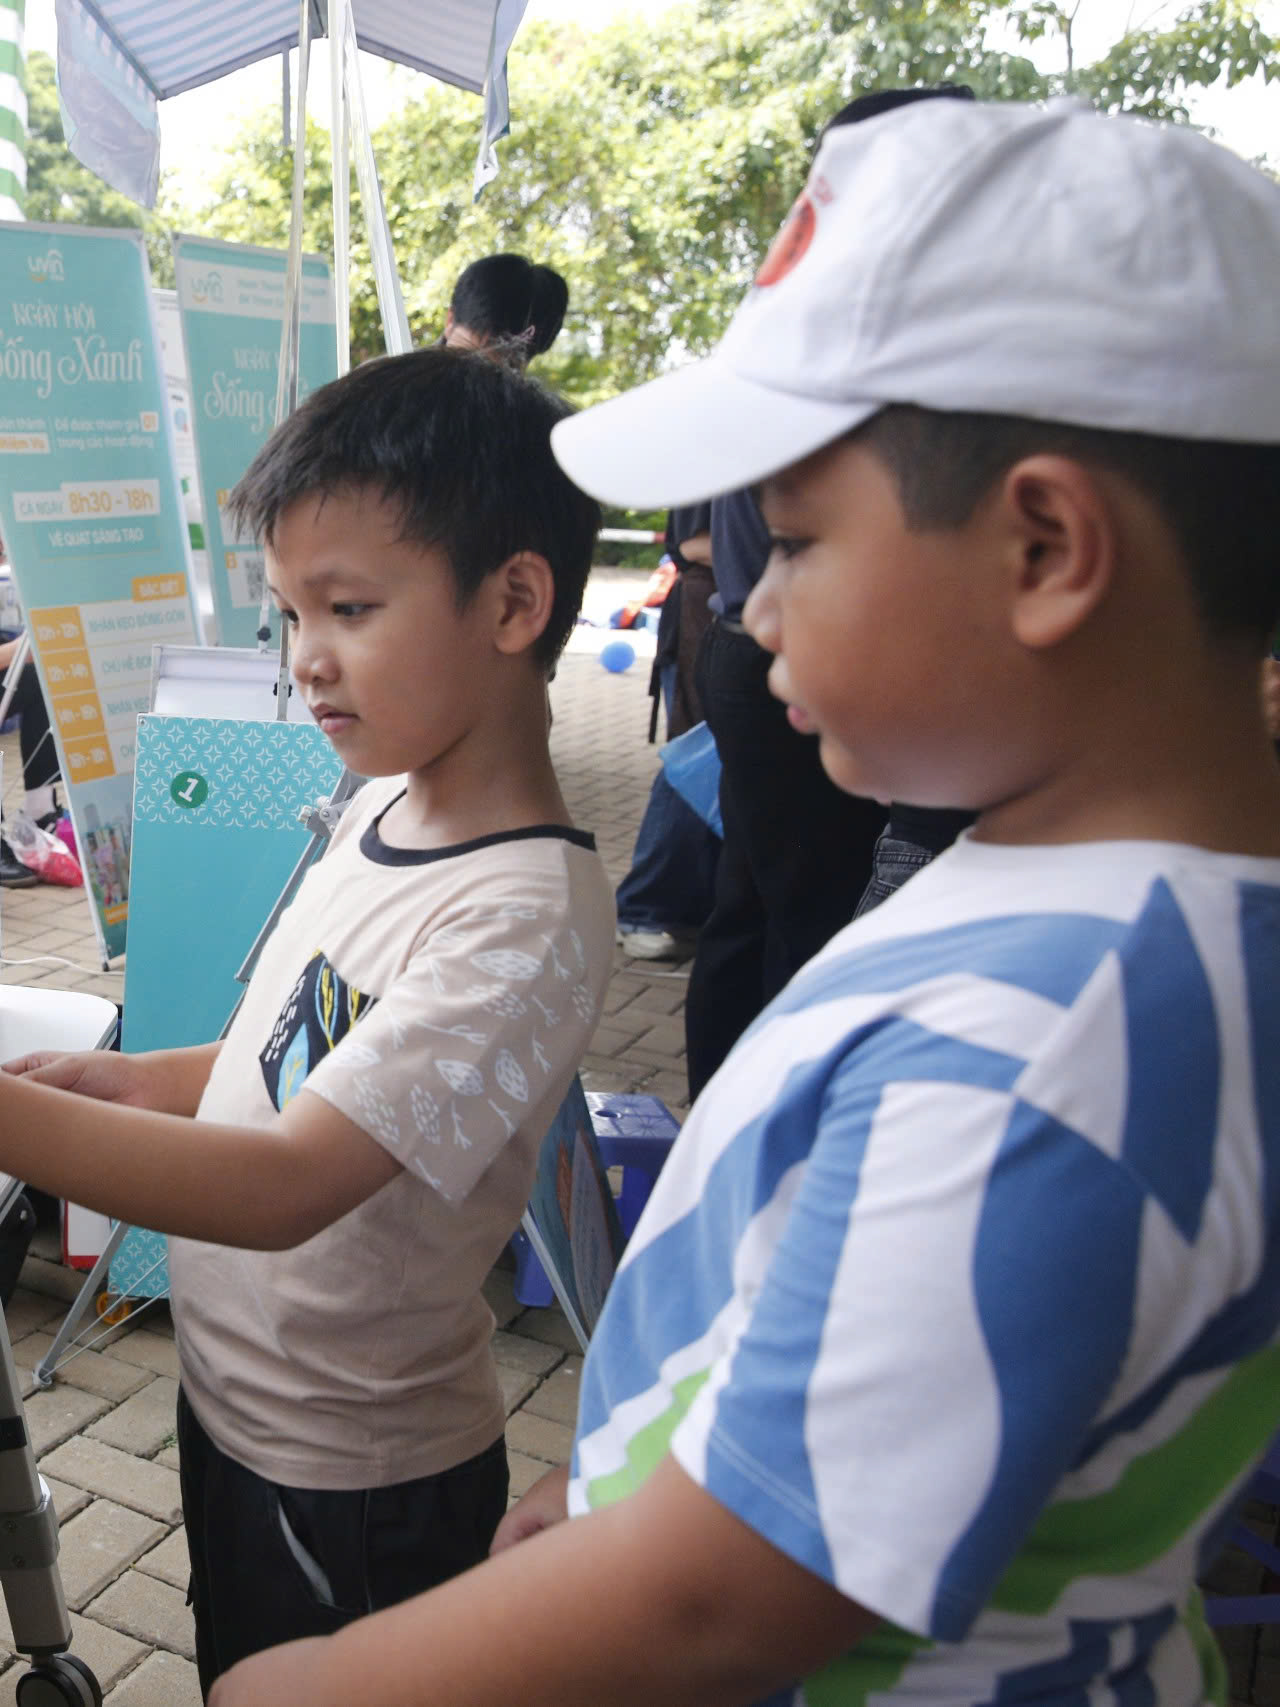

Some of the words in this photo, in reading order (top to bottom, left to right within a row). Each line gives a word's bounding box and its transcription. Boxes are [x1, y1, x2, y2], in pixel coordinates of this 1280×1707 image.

[57, 335, 144, 385] Xanh
[68, 491, 113, 514] 8h30
[124, 488, 154, 511] 18h
[177, 777, 199, 802] 1
